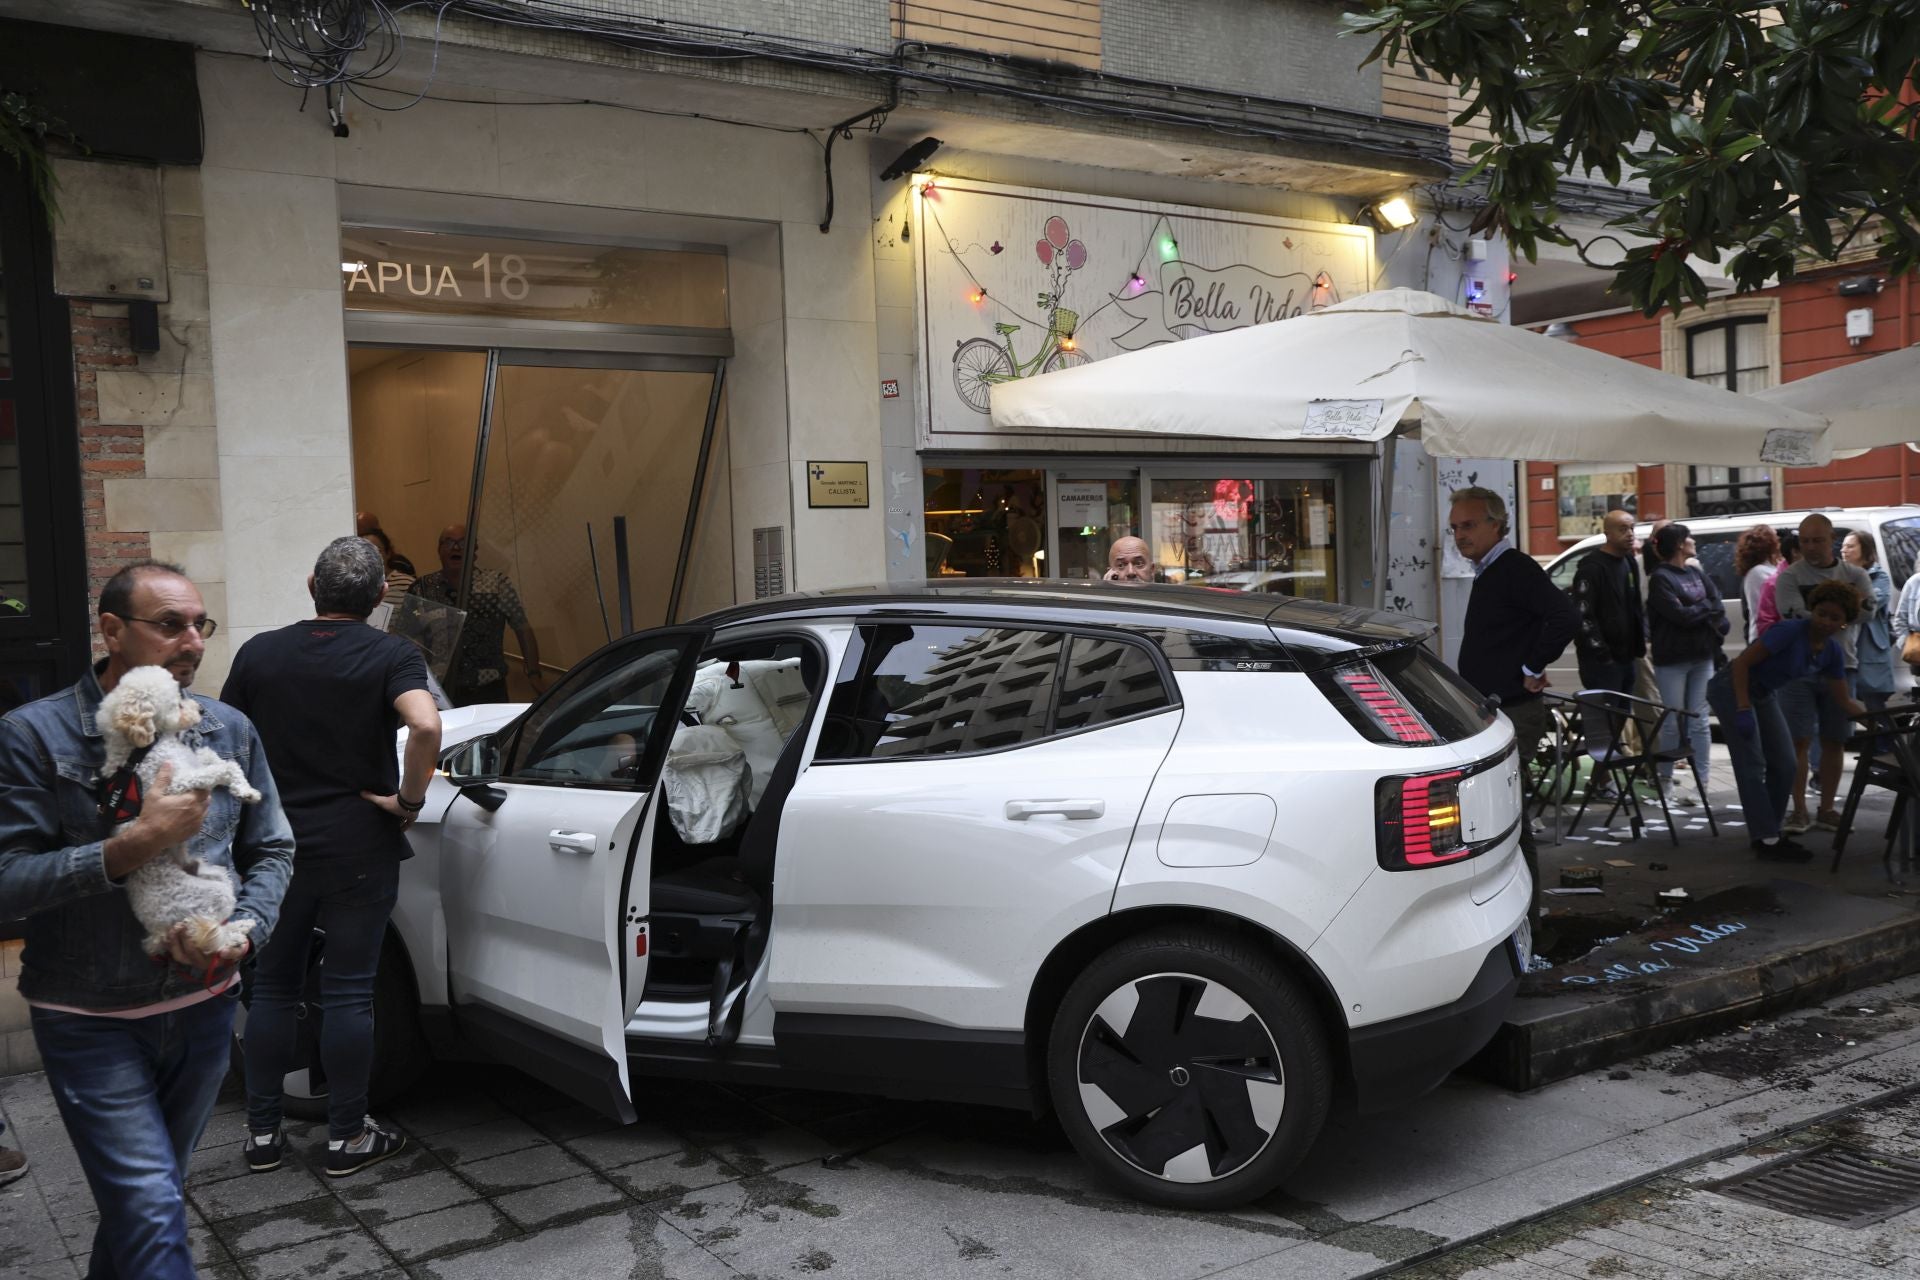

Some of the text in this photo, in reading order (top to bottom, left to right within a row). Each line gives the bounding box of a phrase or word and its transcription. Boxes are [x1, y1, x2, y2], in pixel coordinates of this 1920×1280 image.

[343, 252, 529, 301] APUA 18
[1169, 276, 1241, 319] Bella
[110, 789, 122, 808] NEL
